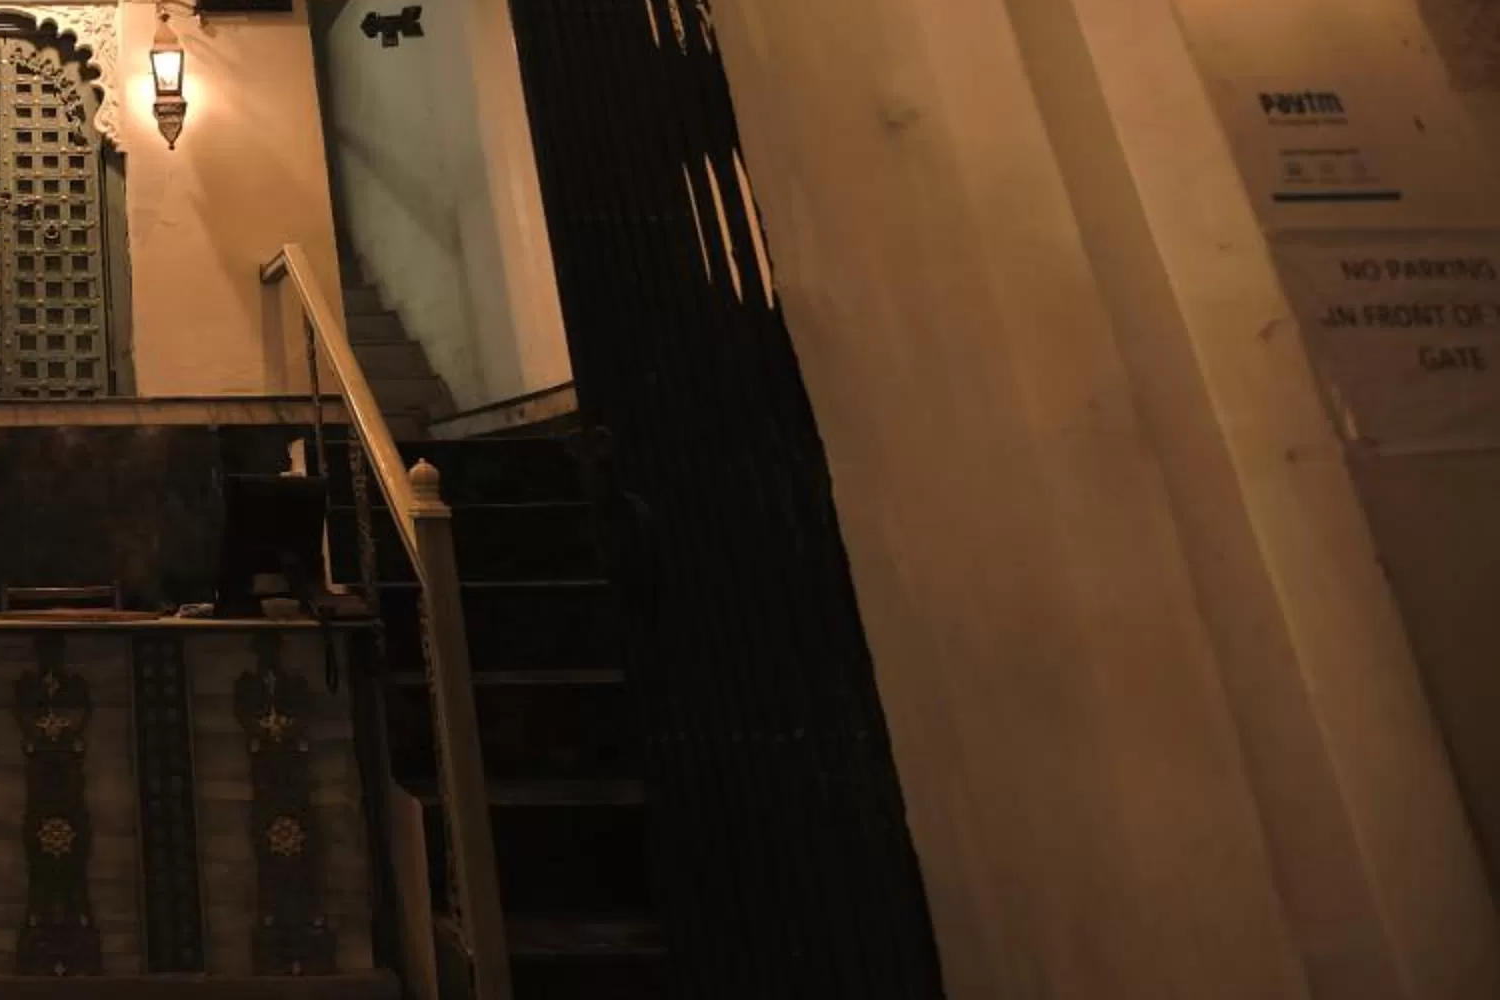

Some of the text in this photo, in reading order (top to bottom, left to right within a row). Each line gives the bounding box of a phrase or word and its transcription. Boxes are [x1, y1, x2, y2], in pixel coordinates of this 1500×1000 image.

[1340, 258, 1381, 281] NO
[1363, 303, 1445, 328] FRONT
[1418, 346, 1487, 372] GATE
